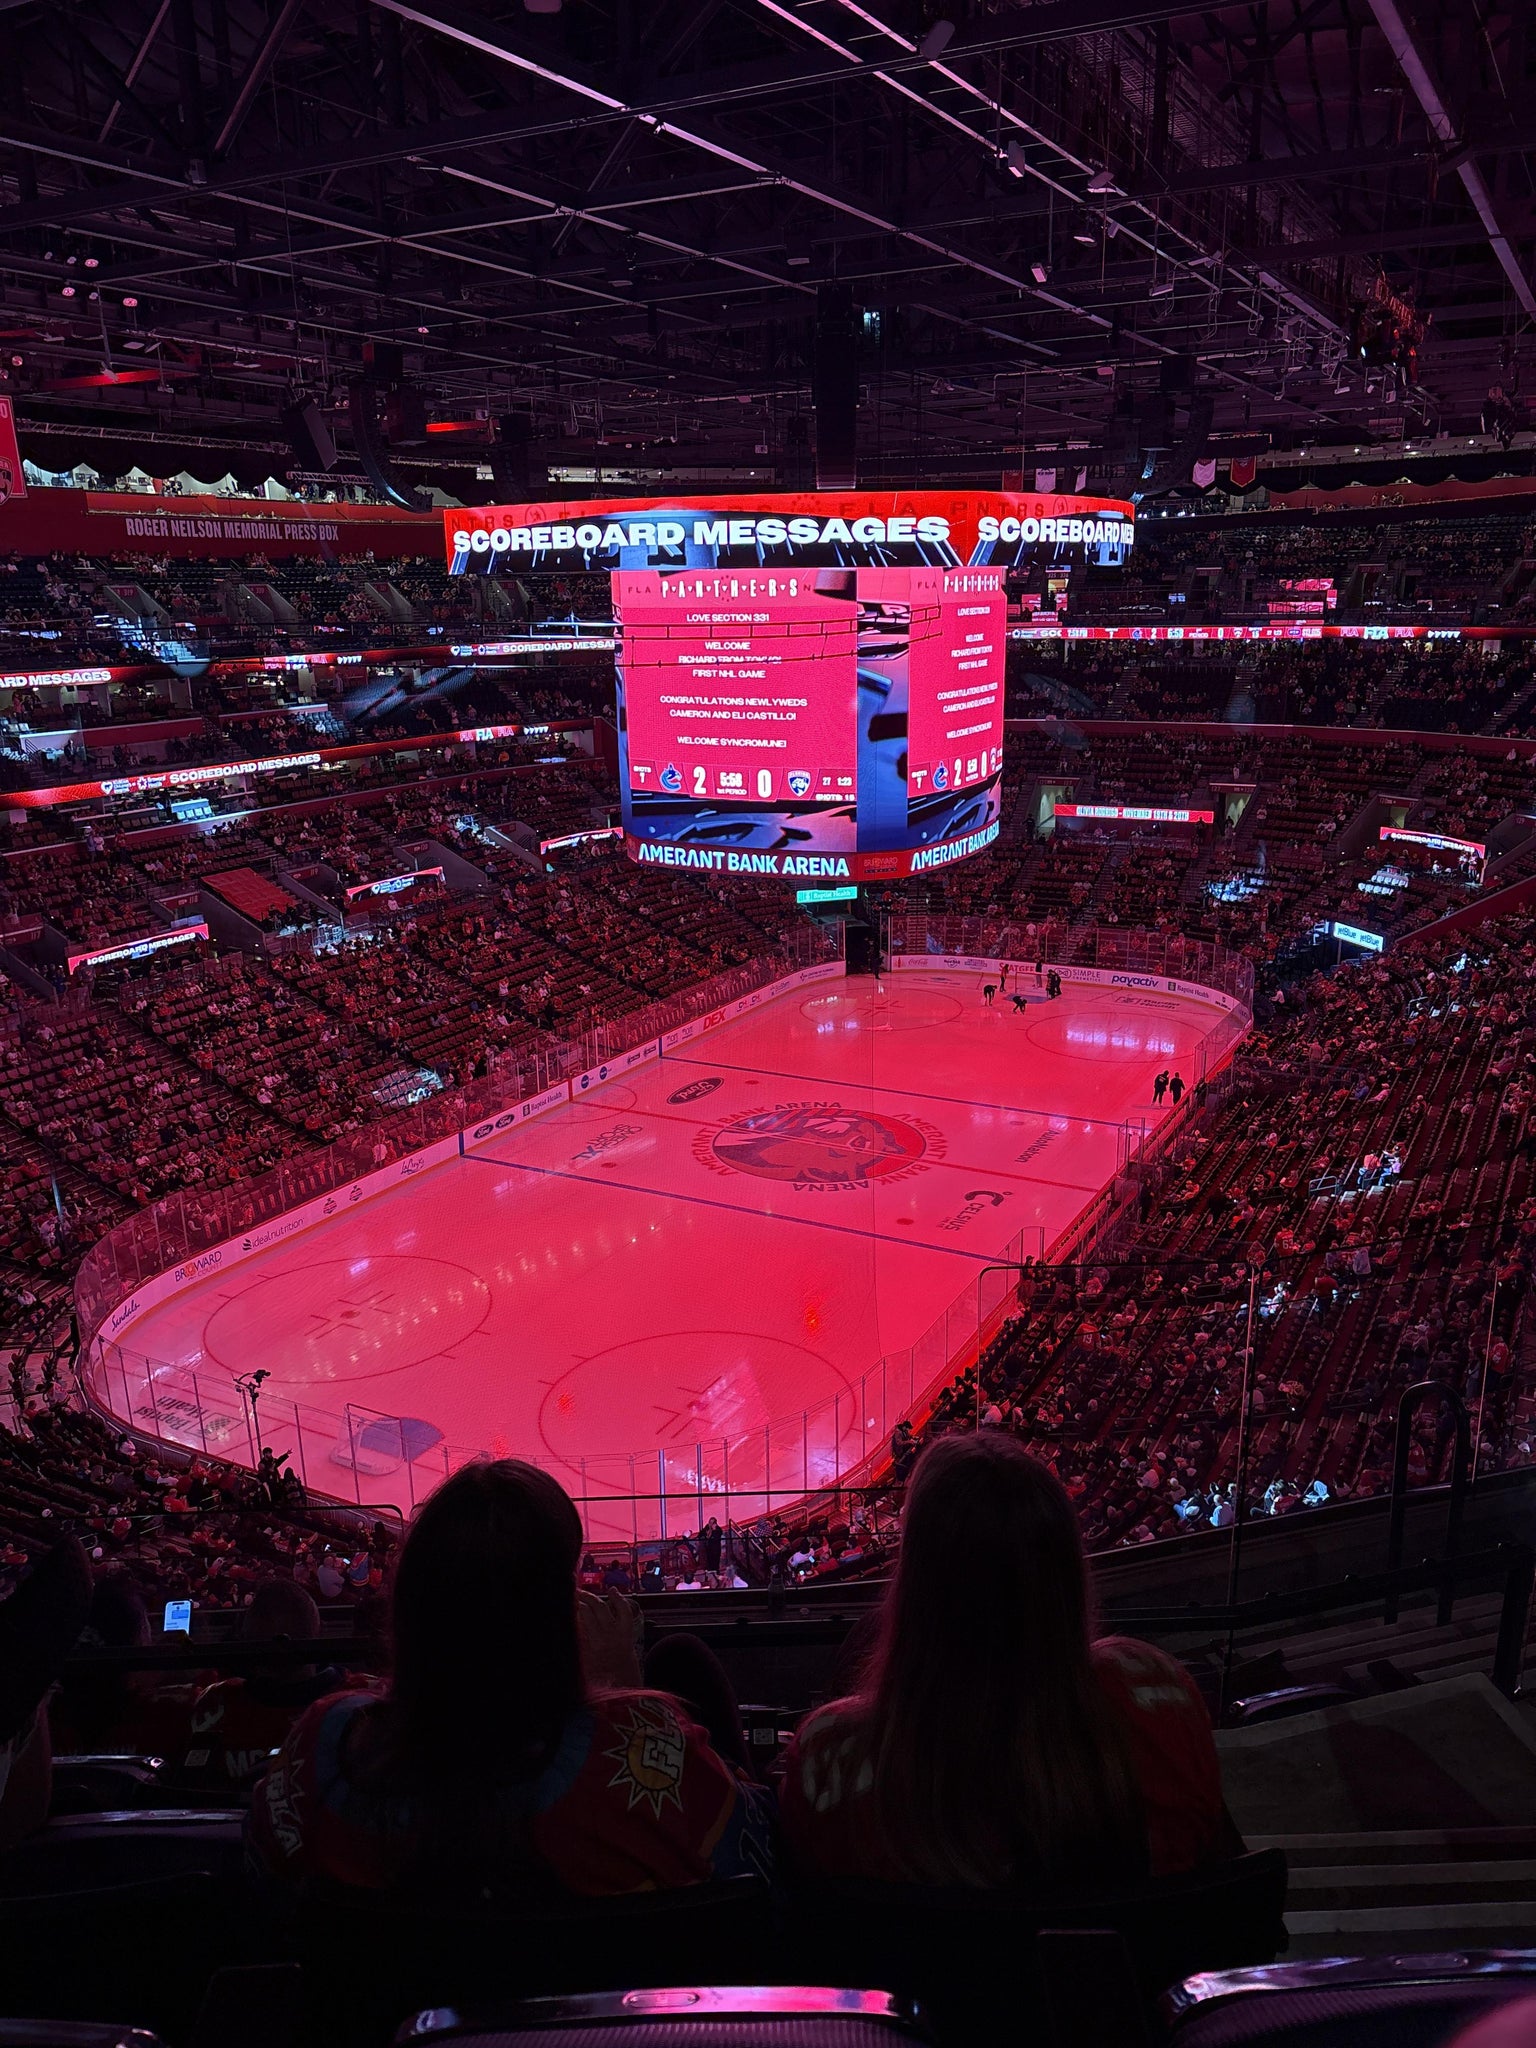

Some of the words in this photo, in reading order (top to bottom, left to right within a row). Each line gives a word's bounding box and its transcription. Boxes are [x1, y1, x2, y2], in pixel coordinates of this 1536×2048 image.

[126, 518, 168, 537] ROGER
[171, 520, 222, 539] NEILSON
[224, 522, 282, 540] MEMORIAL
[284, 523, 318, 540] PRESS
[319, 525, 339, 541] BOX
[453, 522, 685, 552] SCOREBOARD
[693, 517, 950, 546] MESSAGES
[978, 517, 1119, 544] SCOREBOARD
[687, 613, 710, 622] LOVE
[711, 613, 752, 622] SECTION
[753, 613, 770, 622] 331
[1394, 628, 1414, 638] FLA
[503, 642, 572, 653] SCOREBOARD
[704, 641, 751, 650] WELCOME
[679, 655, 716, 664] RICHARD
[717, 655, 744, 663] FROM
[29, 671, 112, 687] MESSAGES
[692, 669, 717, 677] FIRST
[719, 670, 737, 678] NHL
[738, 670, 766, 678] GAME
[660, 696, 744, 706] CONGRATULATIONS
[745, 698, 808, 707] NEWLYWEDS
[669, 709, 711, 719] CAMERON
[712, 710, 731, 719] AND
[732, 711, 746, 720] ELI
[677, 736, 719, 746] WELCOME
[169, 762, 257, 784] SCOREBOARD
[258, 753, 321, 771] MESSAGES
[954, 758, 962, 786] 2
[693, 766, 707, 794] 2
[757, 769, 772, 798] 0
[638, 843, 725, 870] AMERANT
[728, 852, 778, 874] BANK
[782, 856, 850, 877] ARENA
[910, 837, 967, 872] AMERANT
[968, 828, 986, 853] BANK
[1337, 927, 1357, 939] jetBlue
[1360, 934, 1380, 947] jetBlue
[1073, 969, 1101, 978] SIMPLE
[1111, 975, 1159, 987] payactiv
[703, 1009, 727, 1031] DEX
[530, 1097, 548, 1112] Baptist
[548, 1091, 563, 1106] Health
[716, 1106, 771, 1124] BANK
[774, 1101, 843, 1110] ARENA
[892, 1113, 948, 1160] AMERANT
[874, 1163, 931, 1186] BANK
[792, 1181, 869, 1191] ARENA
[943, 1202, 985, 1231] CELSIUS
[110, 1300, 141, 1331] Sandals
